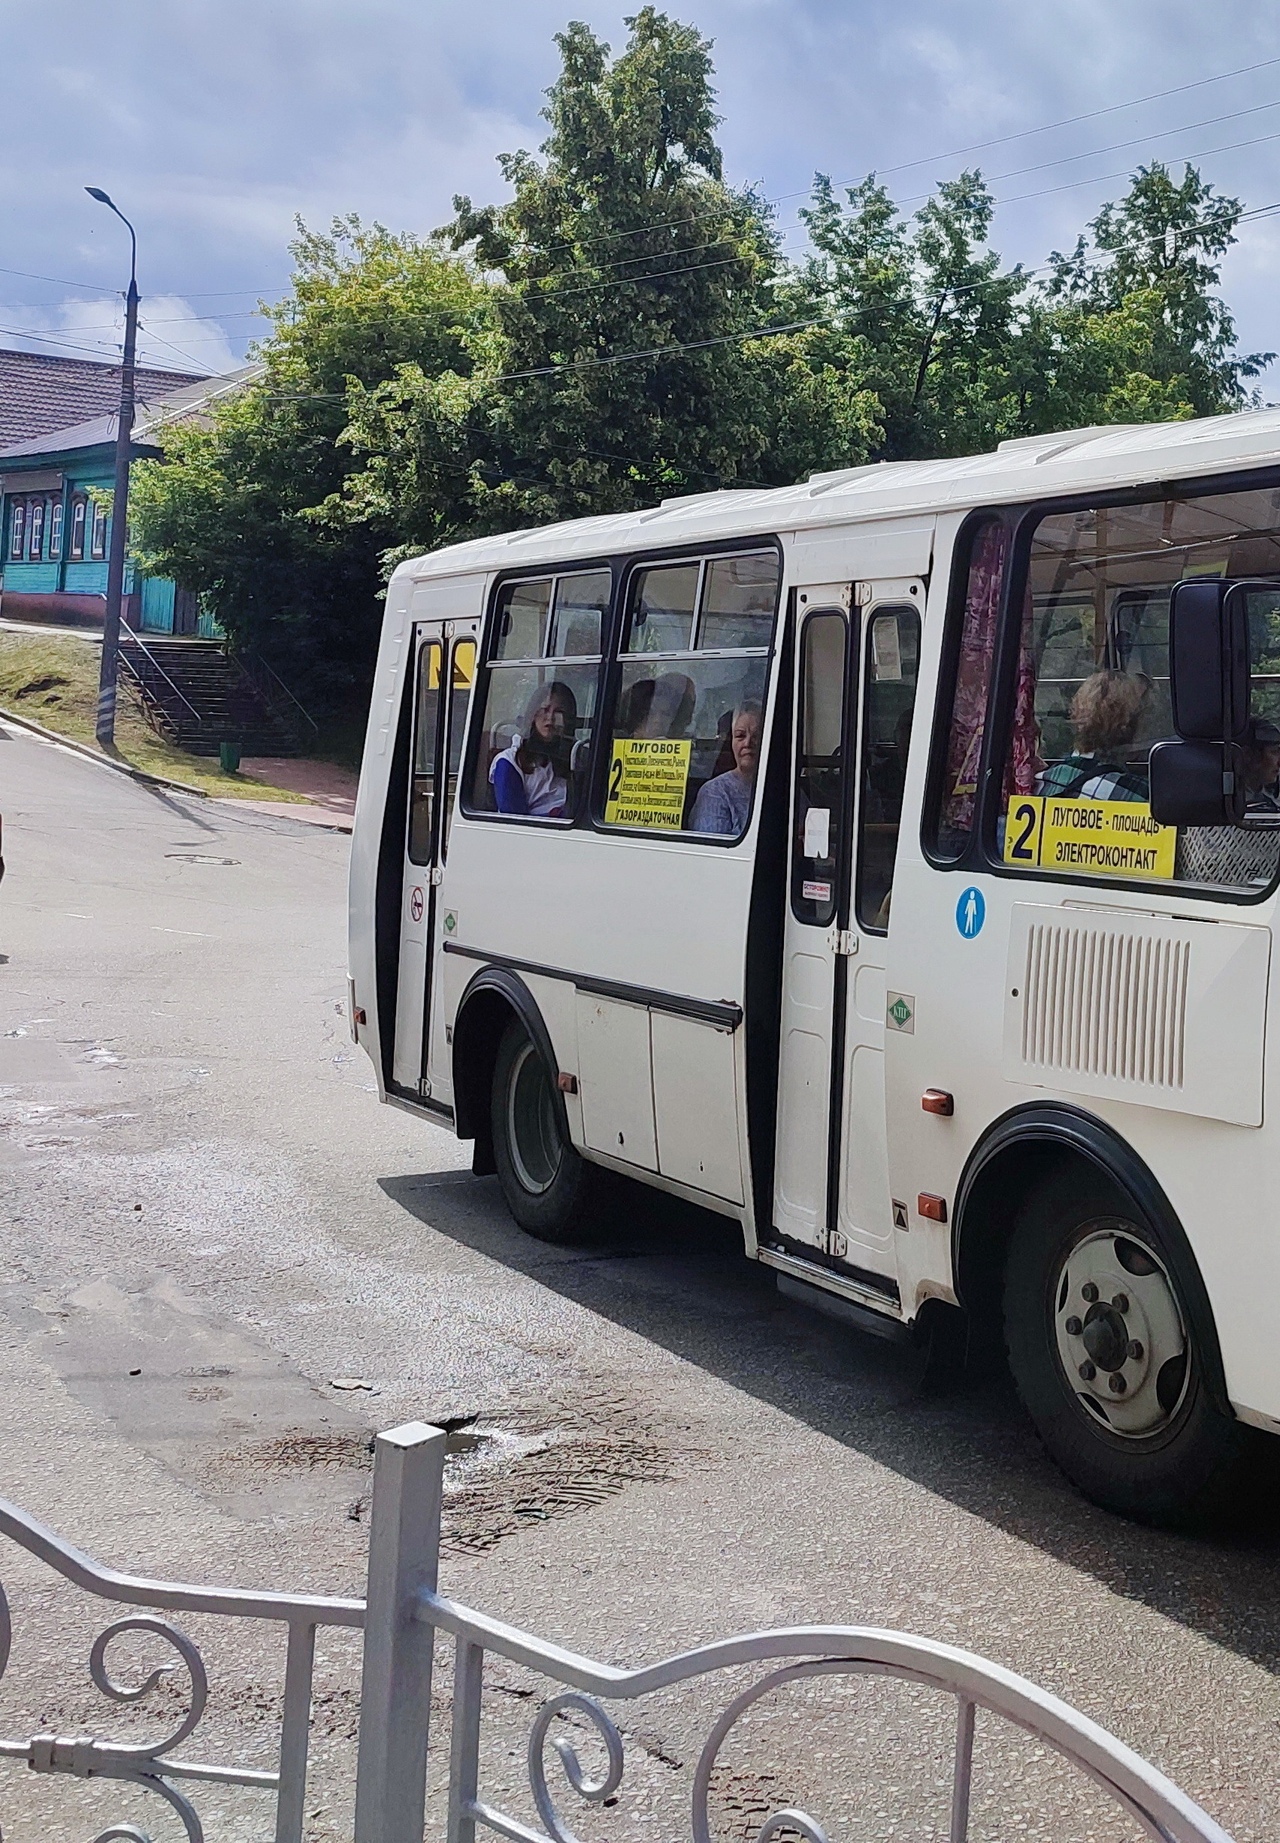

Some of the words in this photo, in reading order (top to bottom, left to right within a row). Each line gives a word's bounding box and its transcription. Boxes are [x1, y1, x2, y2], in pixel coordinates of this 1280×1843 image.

[630, 742, 681, 754] ЛУГОВОЕ
[608, 757, 623, 802] 2
[617, 808, 680, 826] ГАЗОРАЗДАТОЧНАЯ
[1011, 803, 1037, 860] 2
[1050, 806, 1104, 829] ЛУГОВОЕ
[1111, 813, 1160, 837] ПЛОЩАДЬ
[1055, 841, 1158, 871] ЭЛЕКТРОКОНТАКТ
